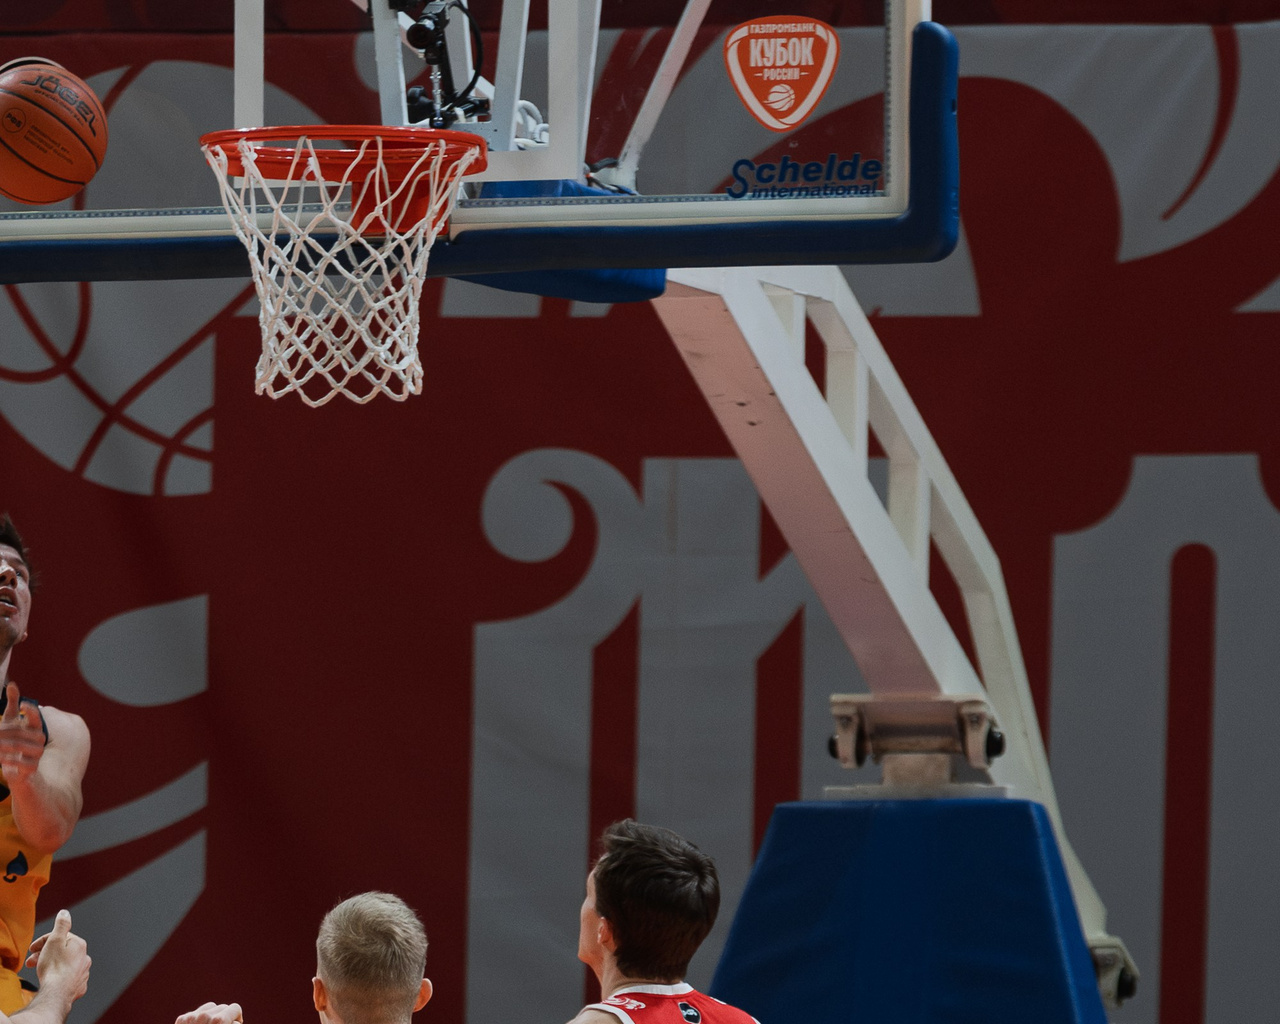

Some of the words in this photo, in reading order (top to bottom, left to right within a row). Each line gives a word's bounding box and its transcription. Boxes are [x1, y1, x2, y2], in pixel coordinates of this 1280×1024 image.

[750, 23, 815, 33] ГАЗПРОМБАНК
[750, 37, 814, 67] КУБОК
[764, 68, 800, 80] РОССИИ
[726, 153, 882, 198] Schelde
[751, 181, 877, 198] international
